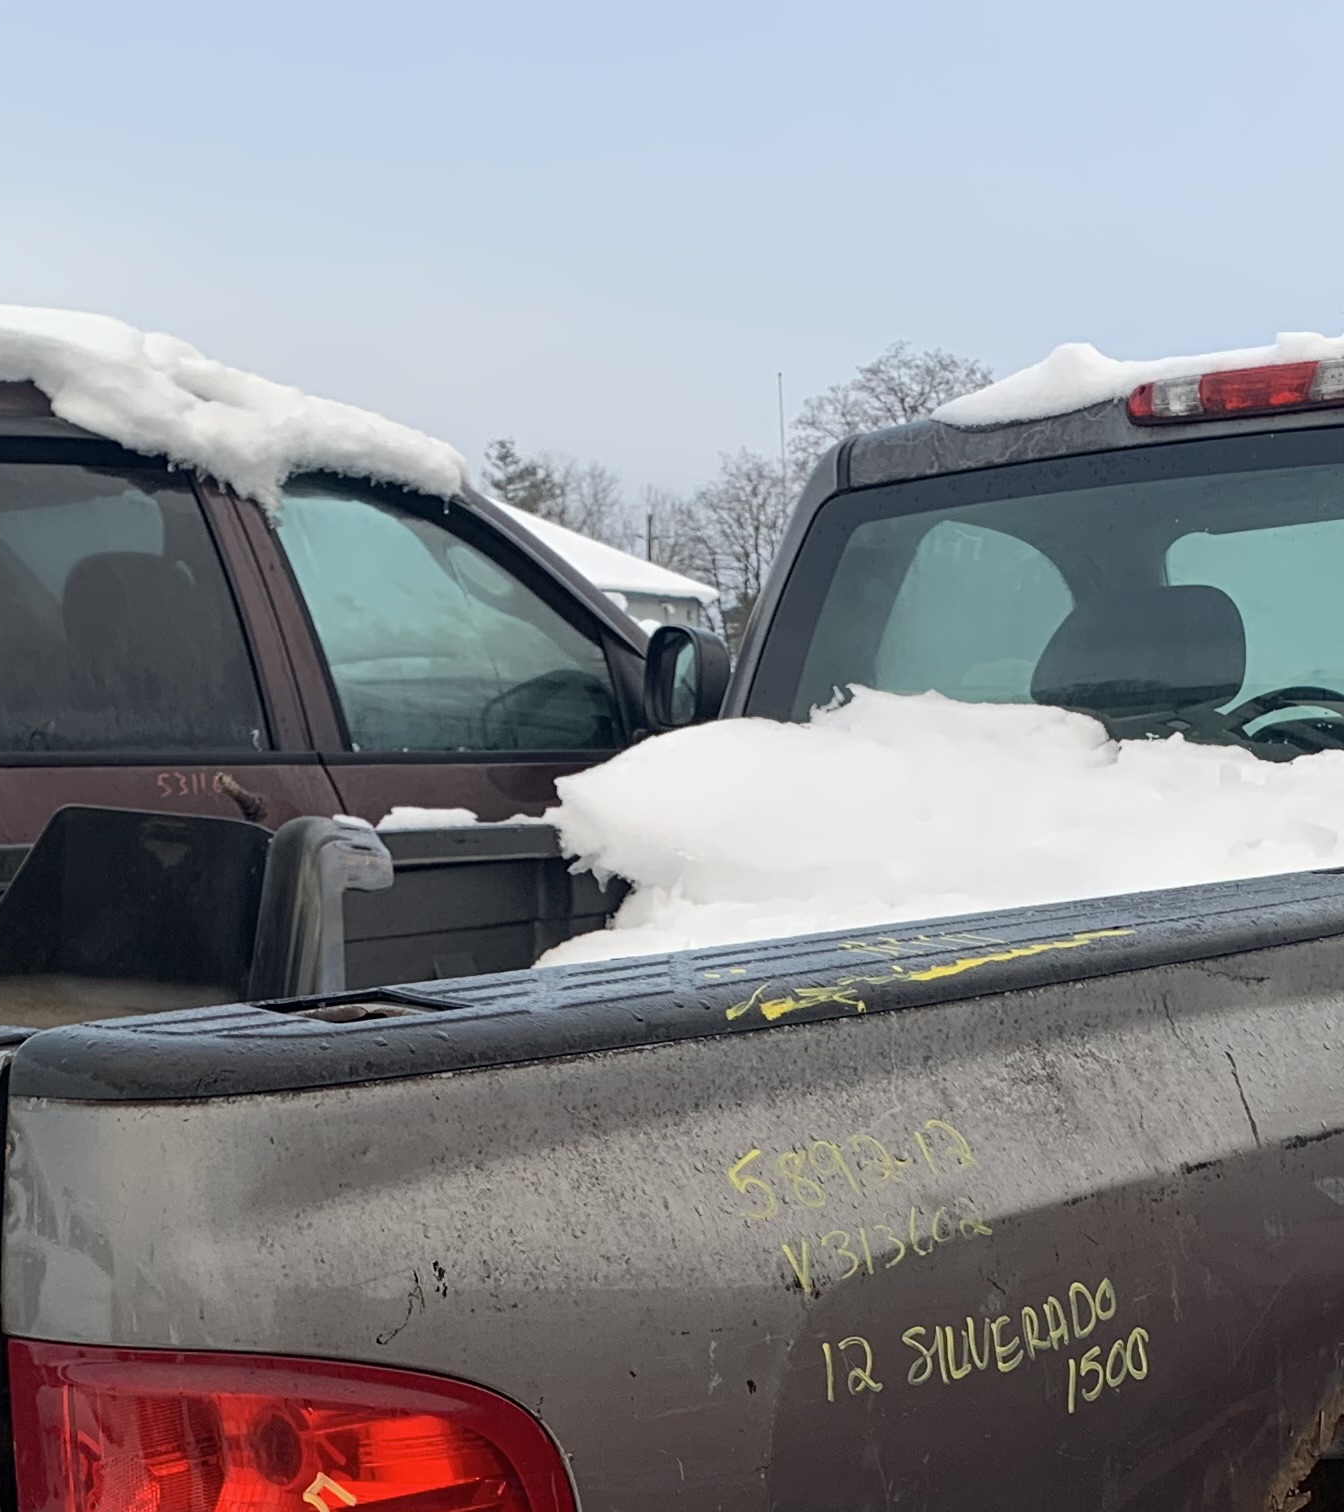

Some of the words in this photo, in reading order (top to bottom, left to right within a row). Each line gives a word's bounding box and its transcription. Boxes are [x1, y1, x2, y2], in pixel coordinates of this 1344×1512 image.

[728, 1119, 977, 1219] 5892-12
[823, 1336, 883, 1402] 12
[902, 1277, 1118, 1387] SILVERADO
[1067, 1326, 1150, 1414] 1500
